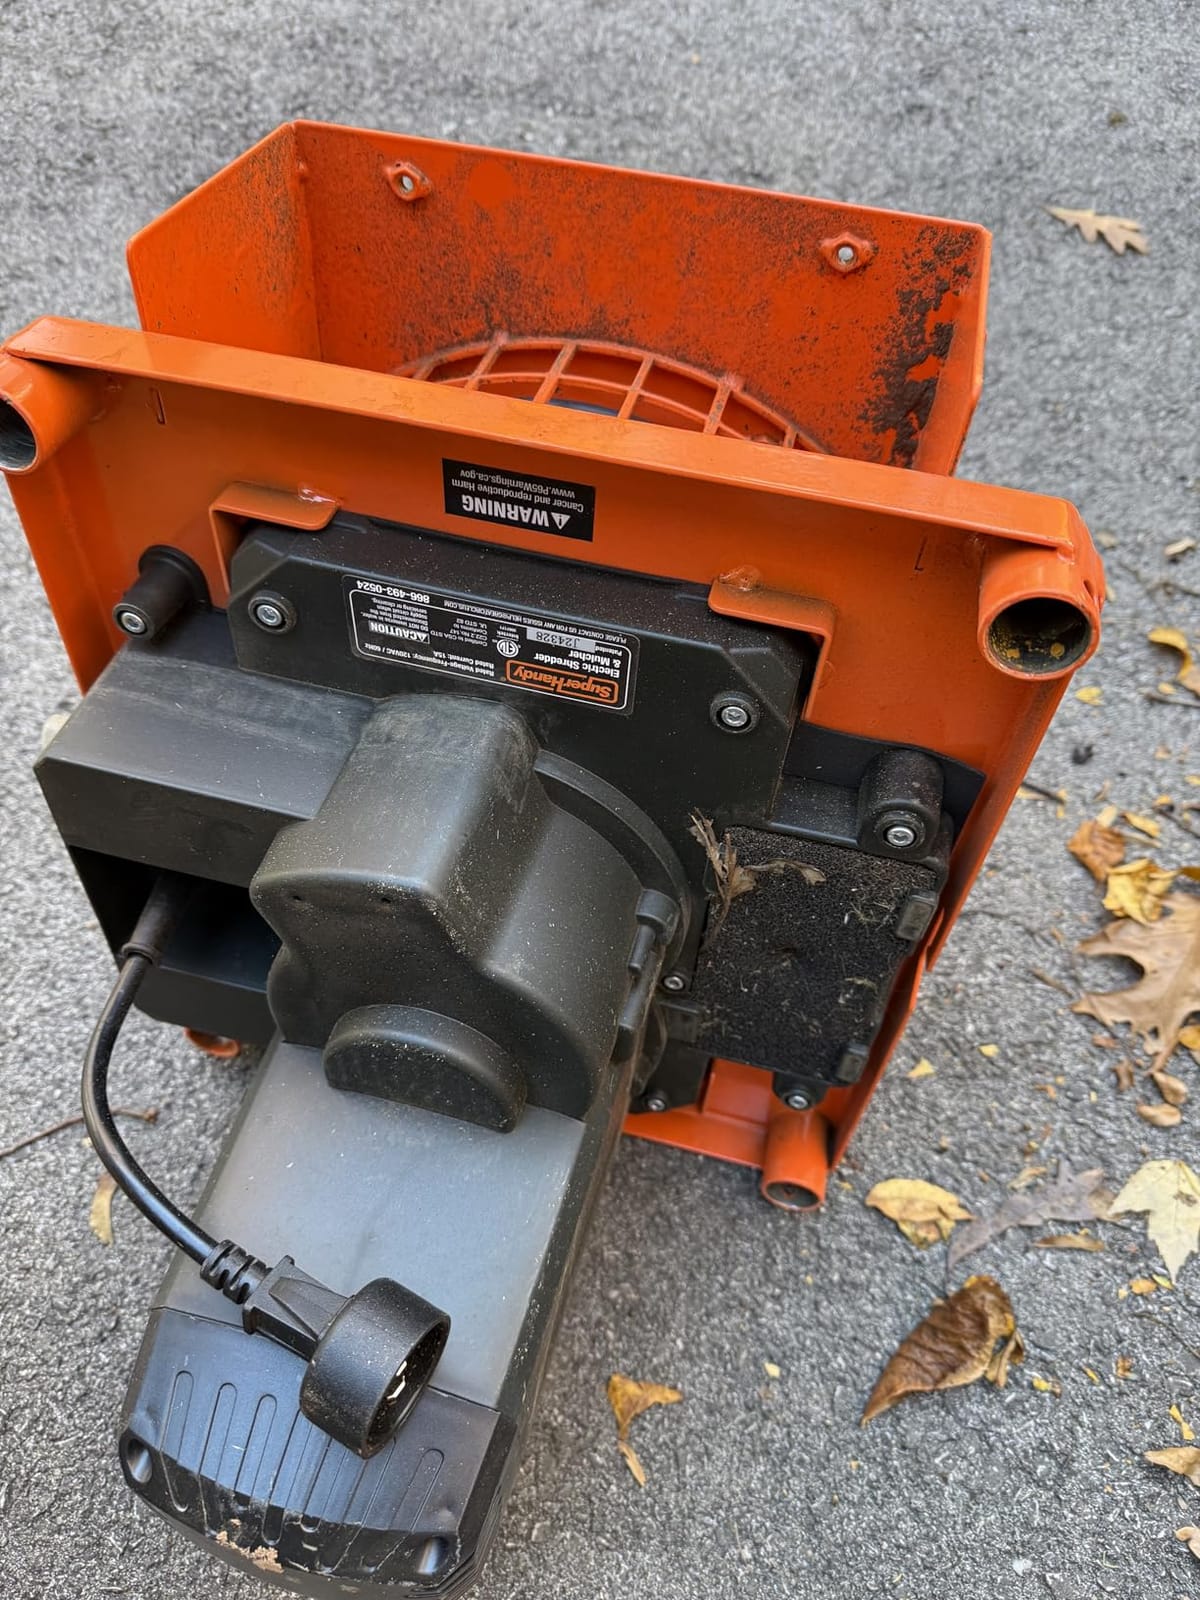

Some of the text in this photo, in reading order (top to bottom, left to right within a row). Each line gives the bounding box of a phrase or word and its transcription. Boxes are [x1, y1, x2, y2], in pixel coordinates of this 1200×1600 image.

[459, 467, 574, 499] www.P65Warnings.ca.gov
[451, 478, 583, 512] Cancer and reproductive Harm
[460, 494, 549, 526] WARNING
[356, 580, 429, 603] 866-493-0524
[464, 619, 477, 627] STD
[522, 617, 542, 626] ISSUES
[543, 621, 556, 629] ANY
[370, 621, 417, 640] CAUTION
[444, 632, 456, 640] CSA
[470, 632, 487, 640] C22.2
[577, 628, 604, 639] CONTACT
[535, 629, 579, 648] J24328
[604, 634, 626, 644] PLEASE
[364, 642, 380, 651] 60Hz
[386, 647, 410, 658] 120VAC
[433, 650, 494, 669] Rated Current: 15A
[568, 649, 610, 666] Mulcher
[475, 666, 494, 676] Rated
[533, 652, 620, 678] Electric Shredder
[512, 664, 611, 698] SuperHandy
